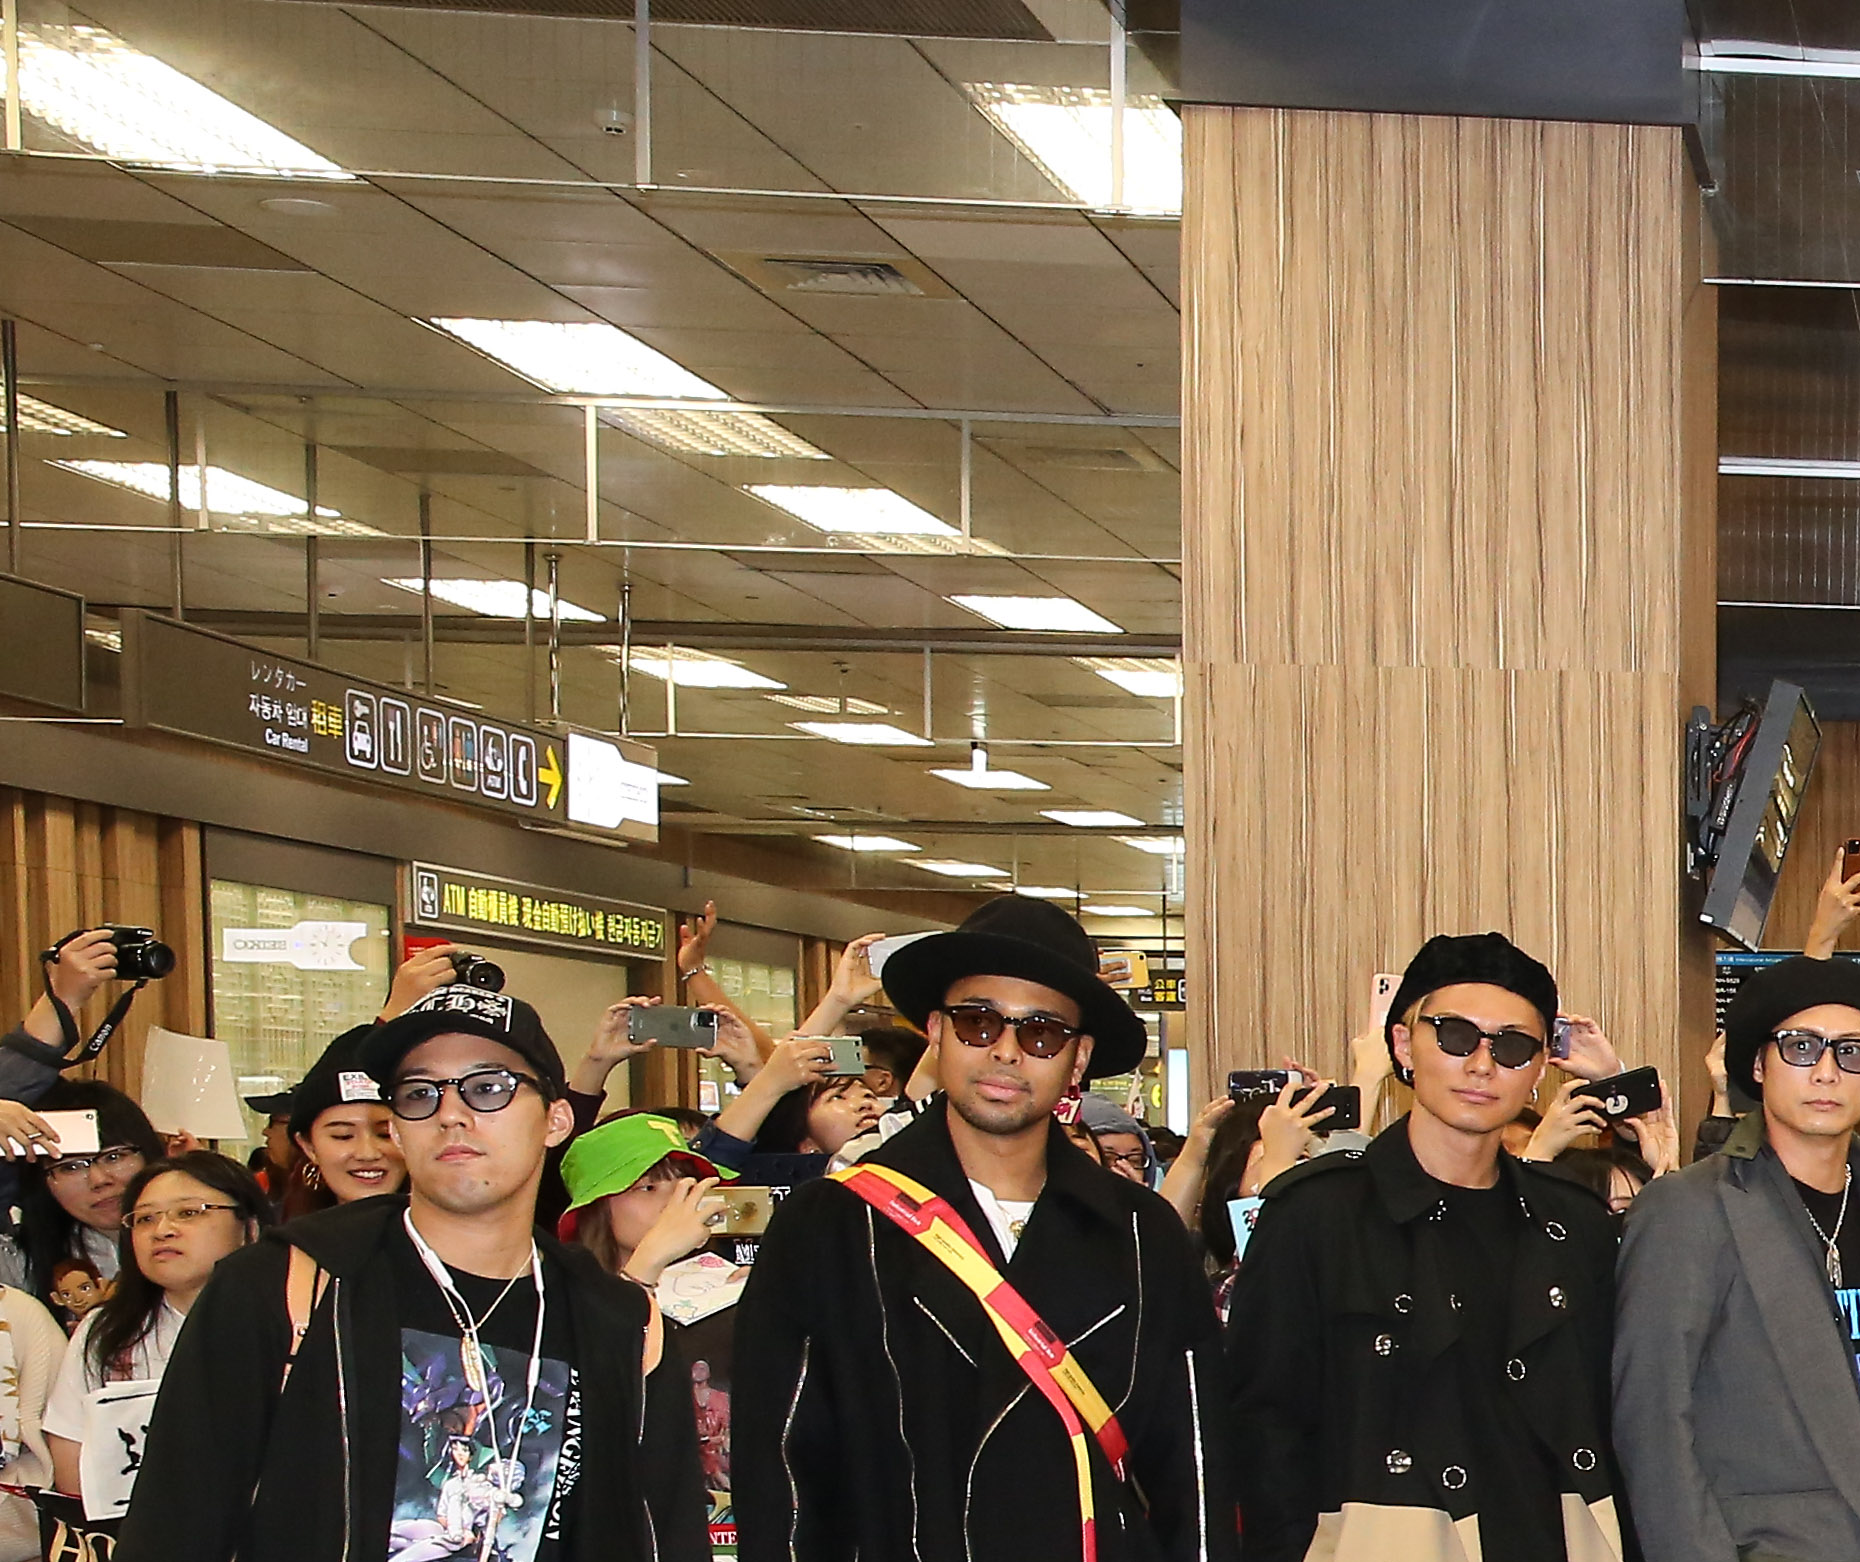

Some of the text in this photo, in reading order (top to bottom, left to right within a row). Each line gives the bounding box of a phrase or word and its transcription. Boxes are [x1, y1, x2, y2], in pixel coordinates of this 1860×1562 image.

[251, 660, 307, 691] レンタカー
[311, 700, 343, 739] 租車
[265, 728, 309, 753] Car Rental
[443, 883, 466, 916] ATM
[90, 1023, 113, 1051] Canon
